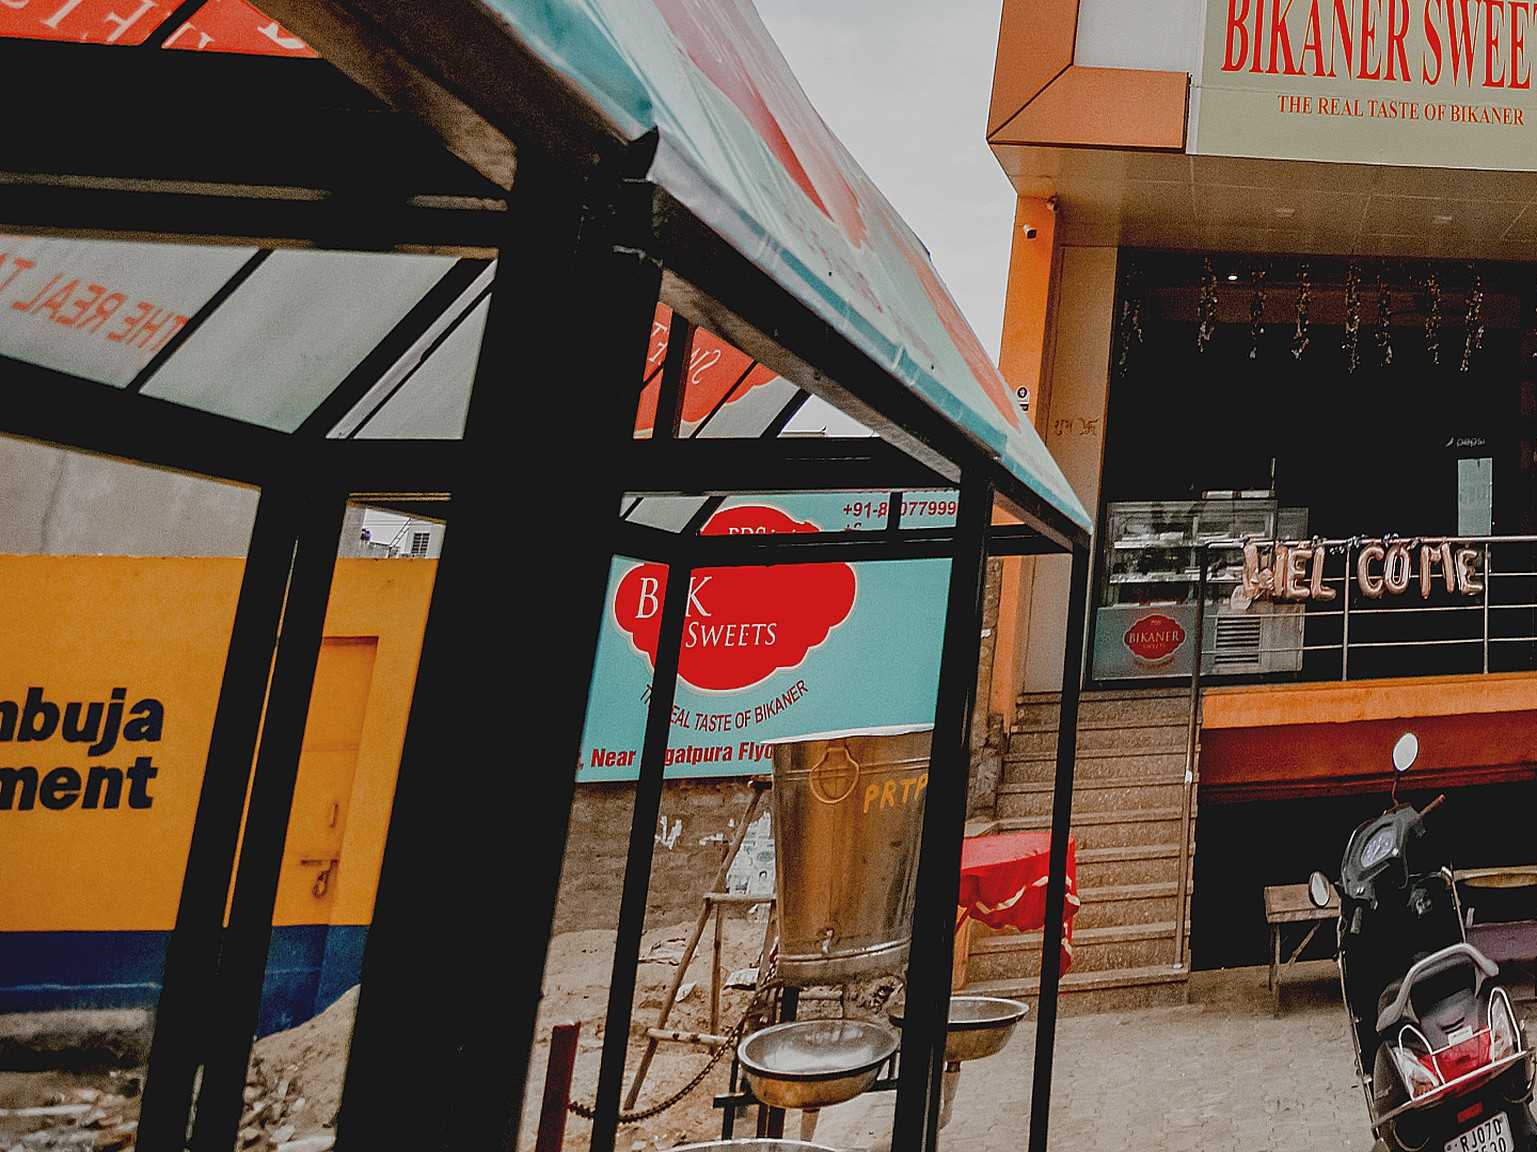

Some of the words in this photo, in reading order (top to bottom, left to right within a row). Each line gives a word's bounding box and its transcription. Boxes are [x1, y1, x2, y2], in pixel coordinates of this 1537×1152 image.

[1278, 94, 1313, 115] THE
[1317, 96, 1364, 118] REAL
[1368, 99, 1420, 121] TASTE
[1424, 102, 1446, 122] OF
[1451, 104, 1526, 127] BIKANER
[634, 575, 713, 619] BK
[685, 621, 777, 648] SWEETS
[670, 705, 691, 729] EAL
[694, 712, 733, 733] TASTE
[735, 710, 751, 729] OF
[754, 679, 809, 724] BIKANER
[591, 748, 637, 768] Near
[664, 742, 733, 766] gatpura
[738, 740, 772, 765] Flyo
